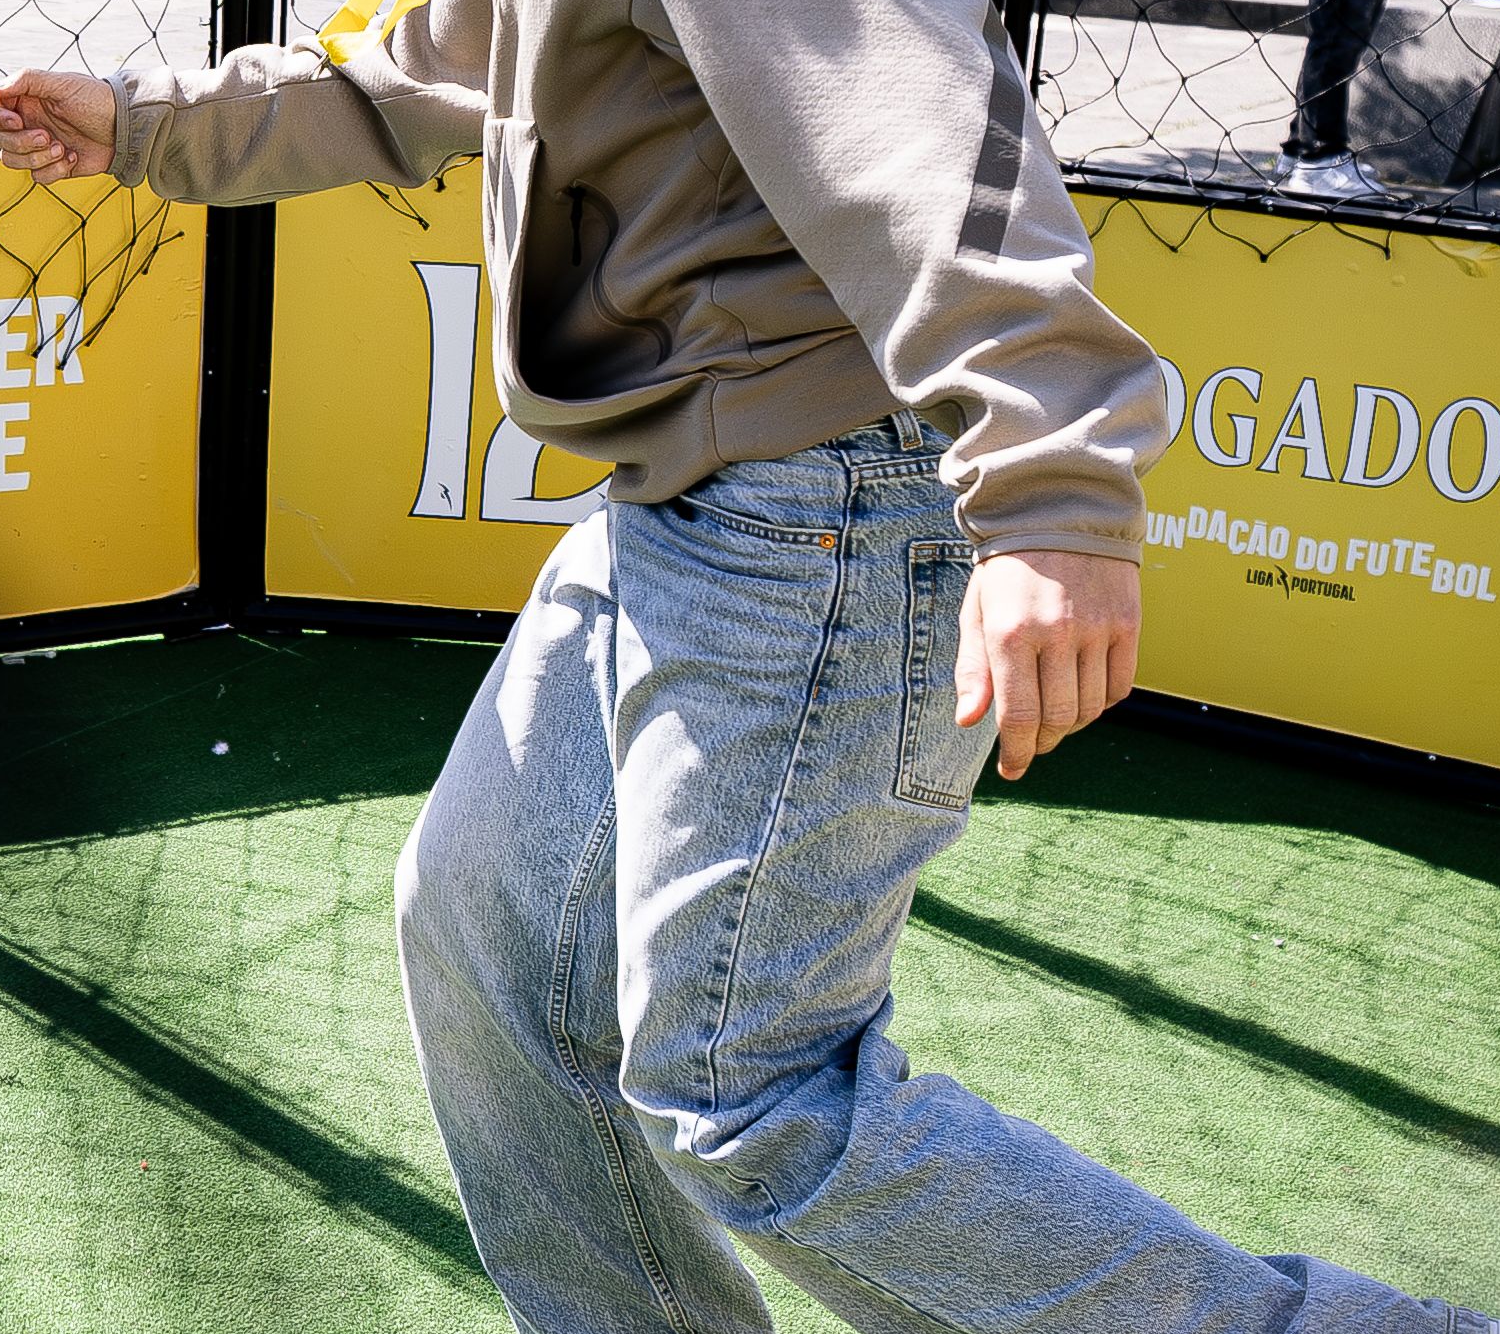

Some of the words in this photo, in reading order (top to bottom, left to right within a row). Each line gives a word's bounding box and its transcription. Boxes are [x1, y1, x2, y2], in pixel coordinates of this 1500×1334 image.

[1145, 505, 1290, 560] UNDAÇÃO
[1295, 536, 1339, 575] DO
[1346, 537, 1497, 603] FUTEBOL
[1245, 568, 1274, 589] LIGA
[1291, 576, 1357, 603] PORTUGAL
